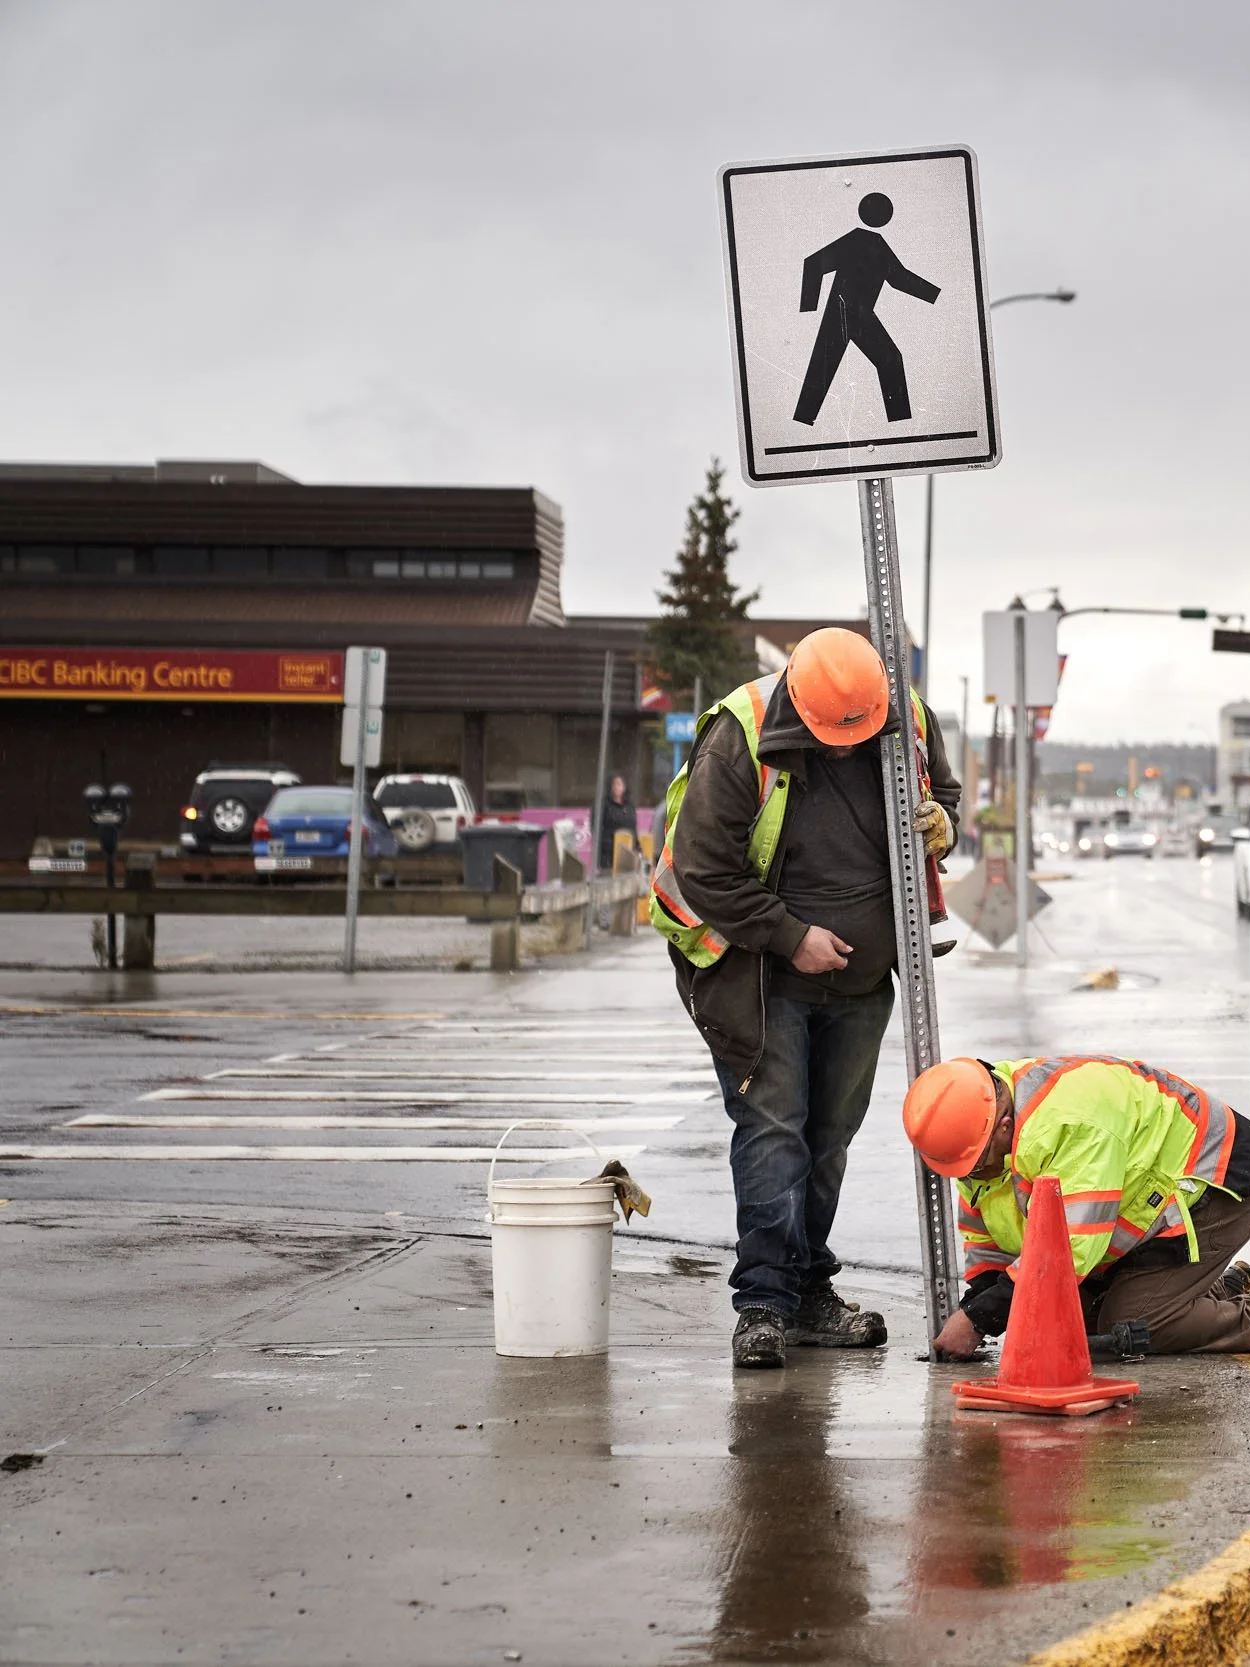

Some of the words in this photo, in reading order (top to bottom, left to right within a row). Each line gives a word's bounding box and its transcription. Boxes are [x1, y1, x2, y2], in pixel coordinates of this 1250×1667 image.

[0, 659, 48, 684] CIBC
[53, 659, 146, 692] Banking
[153, 661, 233, 688] Centre
